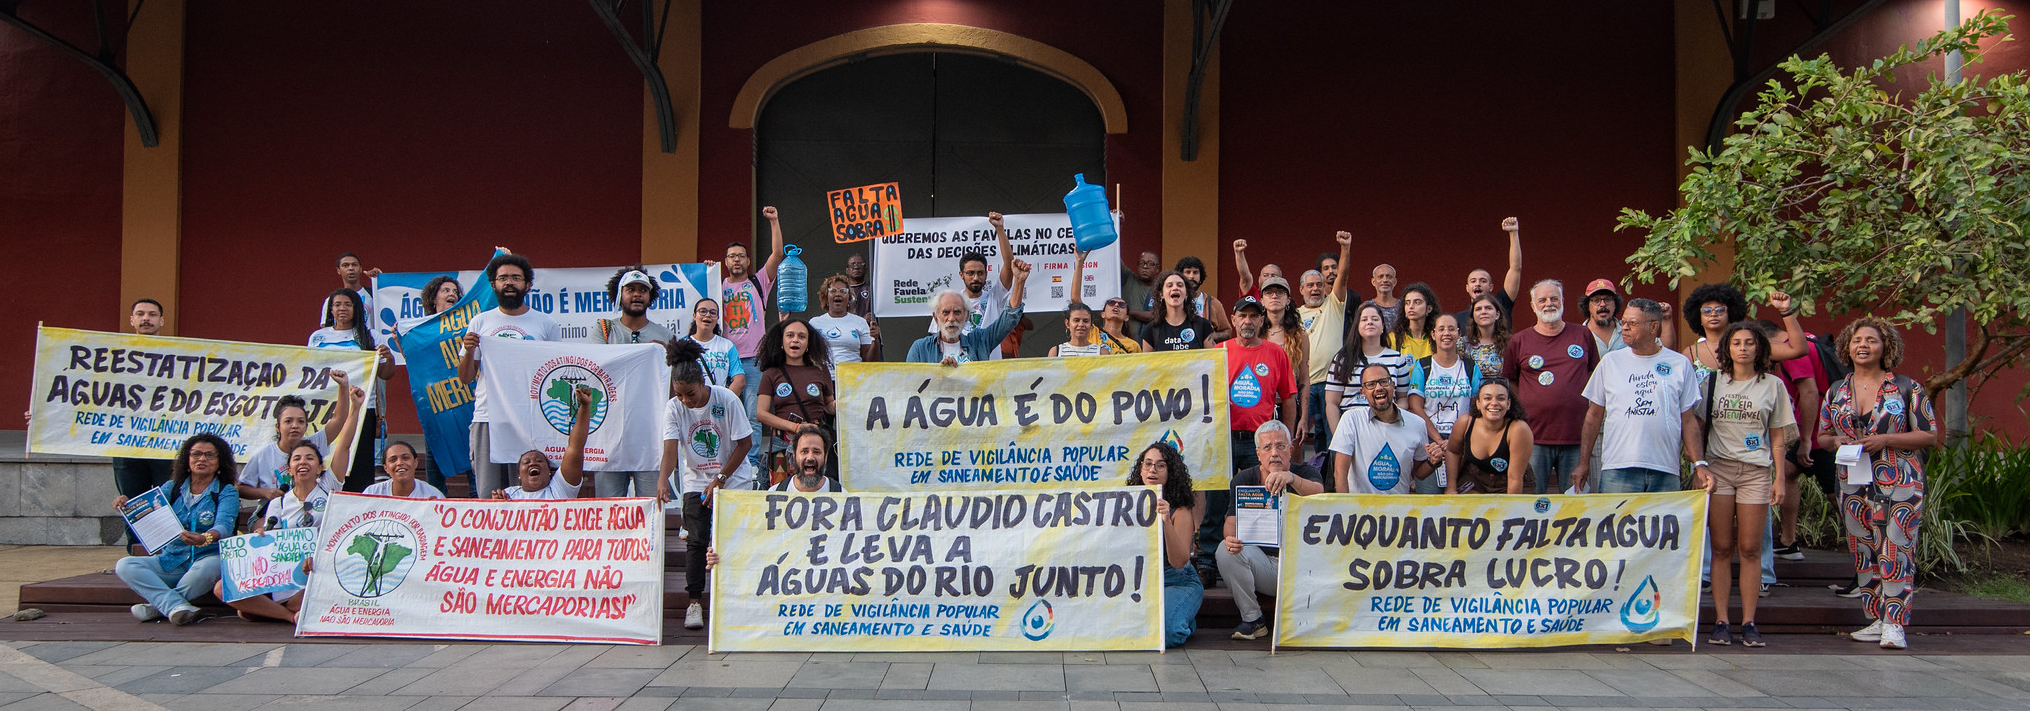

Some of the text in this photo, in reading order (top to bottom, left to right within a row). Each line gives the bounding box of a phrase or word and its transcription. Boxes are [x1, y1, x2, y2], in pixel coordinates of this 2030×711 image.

[830, 185, 898, 209] FALTA
[836, 219, 885, 242] SOBRA
[882, 228, 1052, 244] QUEREMOS AS FAVLAS NO
[907, 241, 1076, 259] DAS DECISÕES LIMÁTICAS
[894, 279, 918, 287] Rede
[894, 288, 926, 296] Favela
[559, 287, 569, 313] É
[731, 305, 743, 315] TI
[298, 366, 332, 390] DA
[530, 356, 618, 403] MOVIMENTO DOS ATINGIDOS POR BARRAGENS
[1628, 370, 1655, 383] Ainda
[1656, 366, 1670, 374] 6x1
[47, 366, 147, 412] ÁGUAS
[1636, 380, 1658, 388] estou
[866, 396, 890, 431] A
[903, 378, 998, 430] ÁGUA
[1013, 376, 1044, 427] É
[1050, 391, 1097, 424] DO
[1718, 397, 1753, 411] FAVELA
[75, 411, 242, 438] REDE DE VIGILÂNCIA POPULAR
[91, 430, 112, 444] EM
[1746, 438, 1760, 446] 6x1
[545, 445, 566, 453] ÁGUA
[894, 441, 1129, 467] REDE DE VIGILÂNCIA POPULAR
[911, 461, 1102, 484] EM SANEAMENTO E SAÚDE
[461, 503, 559, 531] CONJUNTÃO
[563, 505, 603, 531] EXIGE
[607, 503, 646, 531] ÁGUA
[765, 489, 1158, 532] FORA CLAUDIO CASTRO
[1535, 502, 1550, 511] 6x1
[276, 528, 314, 542] HUMANO
[325, 515, 361, 553] MOVIMENTO
[362, 510, 377, 521] DOS
[1303, 514, 1490, 550] ENQUANTO
[1496, 517, 1591, 551] FALTA
[1595, 500, 1680, 550] ÁGUA
[219, 537, 246, 550] PELO
[433, 536, 447, 556] E
[448, 536, 559, 560] SANEAMENTO
[562, 538, 603, 561] PARA
[806, 532, 972, 566] E LEVA A
[424, 561, 623, 590] ÁGUA E ENERGIA NÃO
[756, 552, 874, 596] ÁGUAS
[881, 565, 927, 597] DO
[935, 564, 994, 598] RIO
[1343, 558, 1467, 590] SOBRA
[329, 603, 391, 616] ÁGUA E ENERGIA
[348, 599, 380, 607] BRASIL
[440, 586, 477, 614] SÃO
[778, 597, 1000, 619] REDE DE VIGILÂNCIA POPULAR
[1371, 591, 1613, 616] REDE DE VIGILÂNCIA POPULAR
[336, 614, 351, 625] SÃO
[783, 619, 991, 637] EM SANEAMENTO E SAÚDE
[1378, 615, 1585, 634] EM SANEAMENTO E SAÚDE
